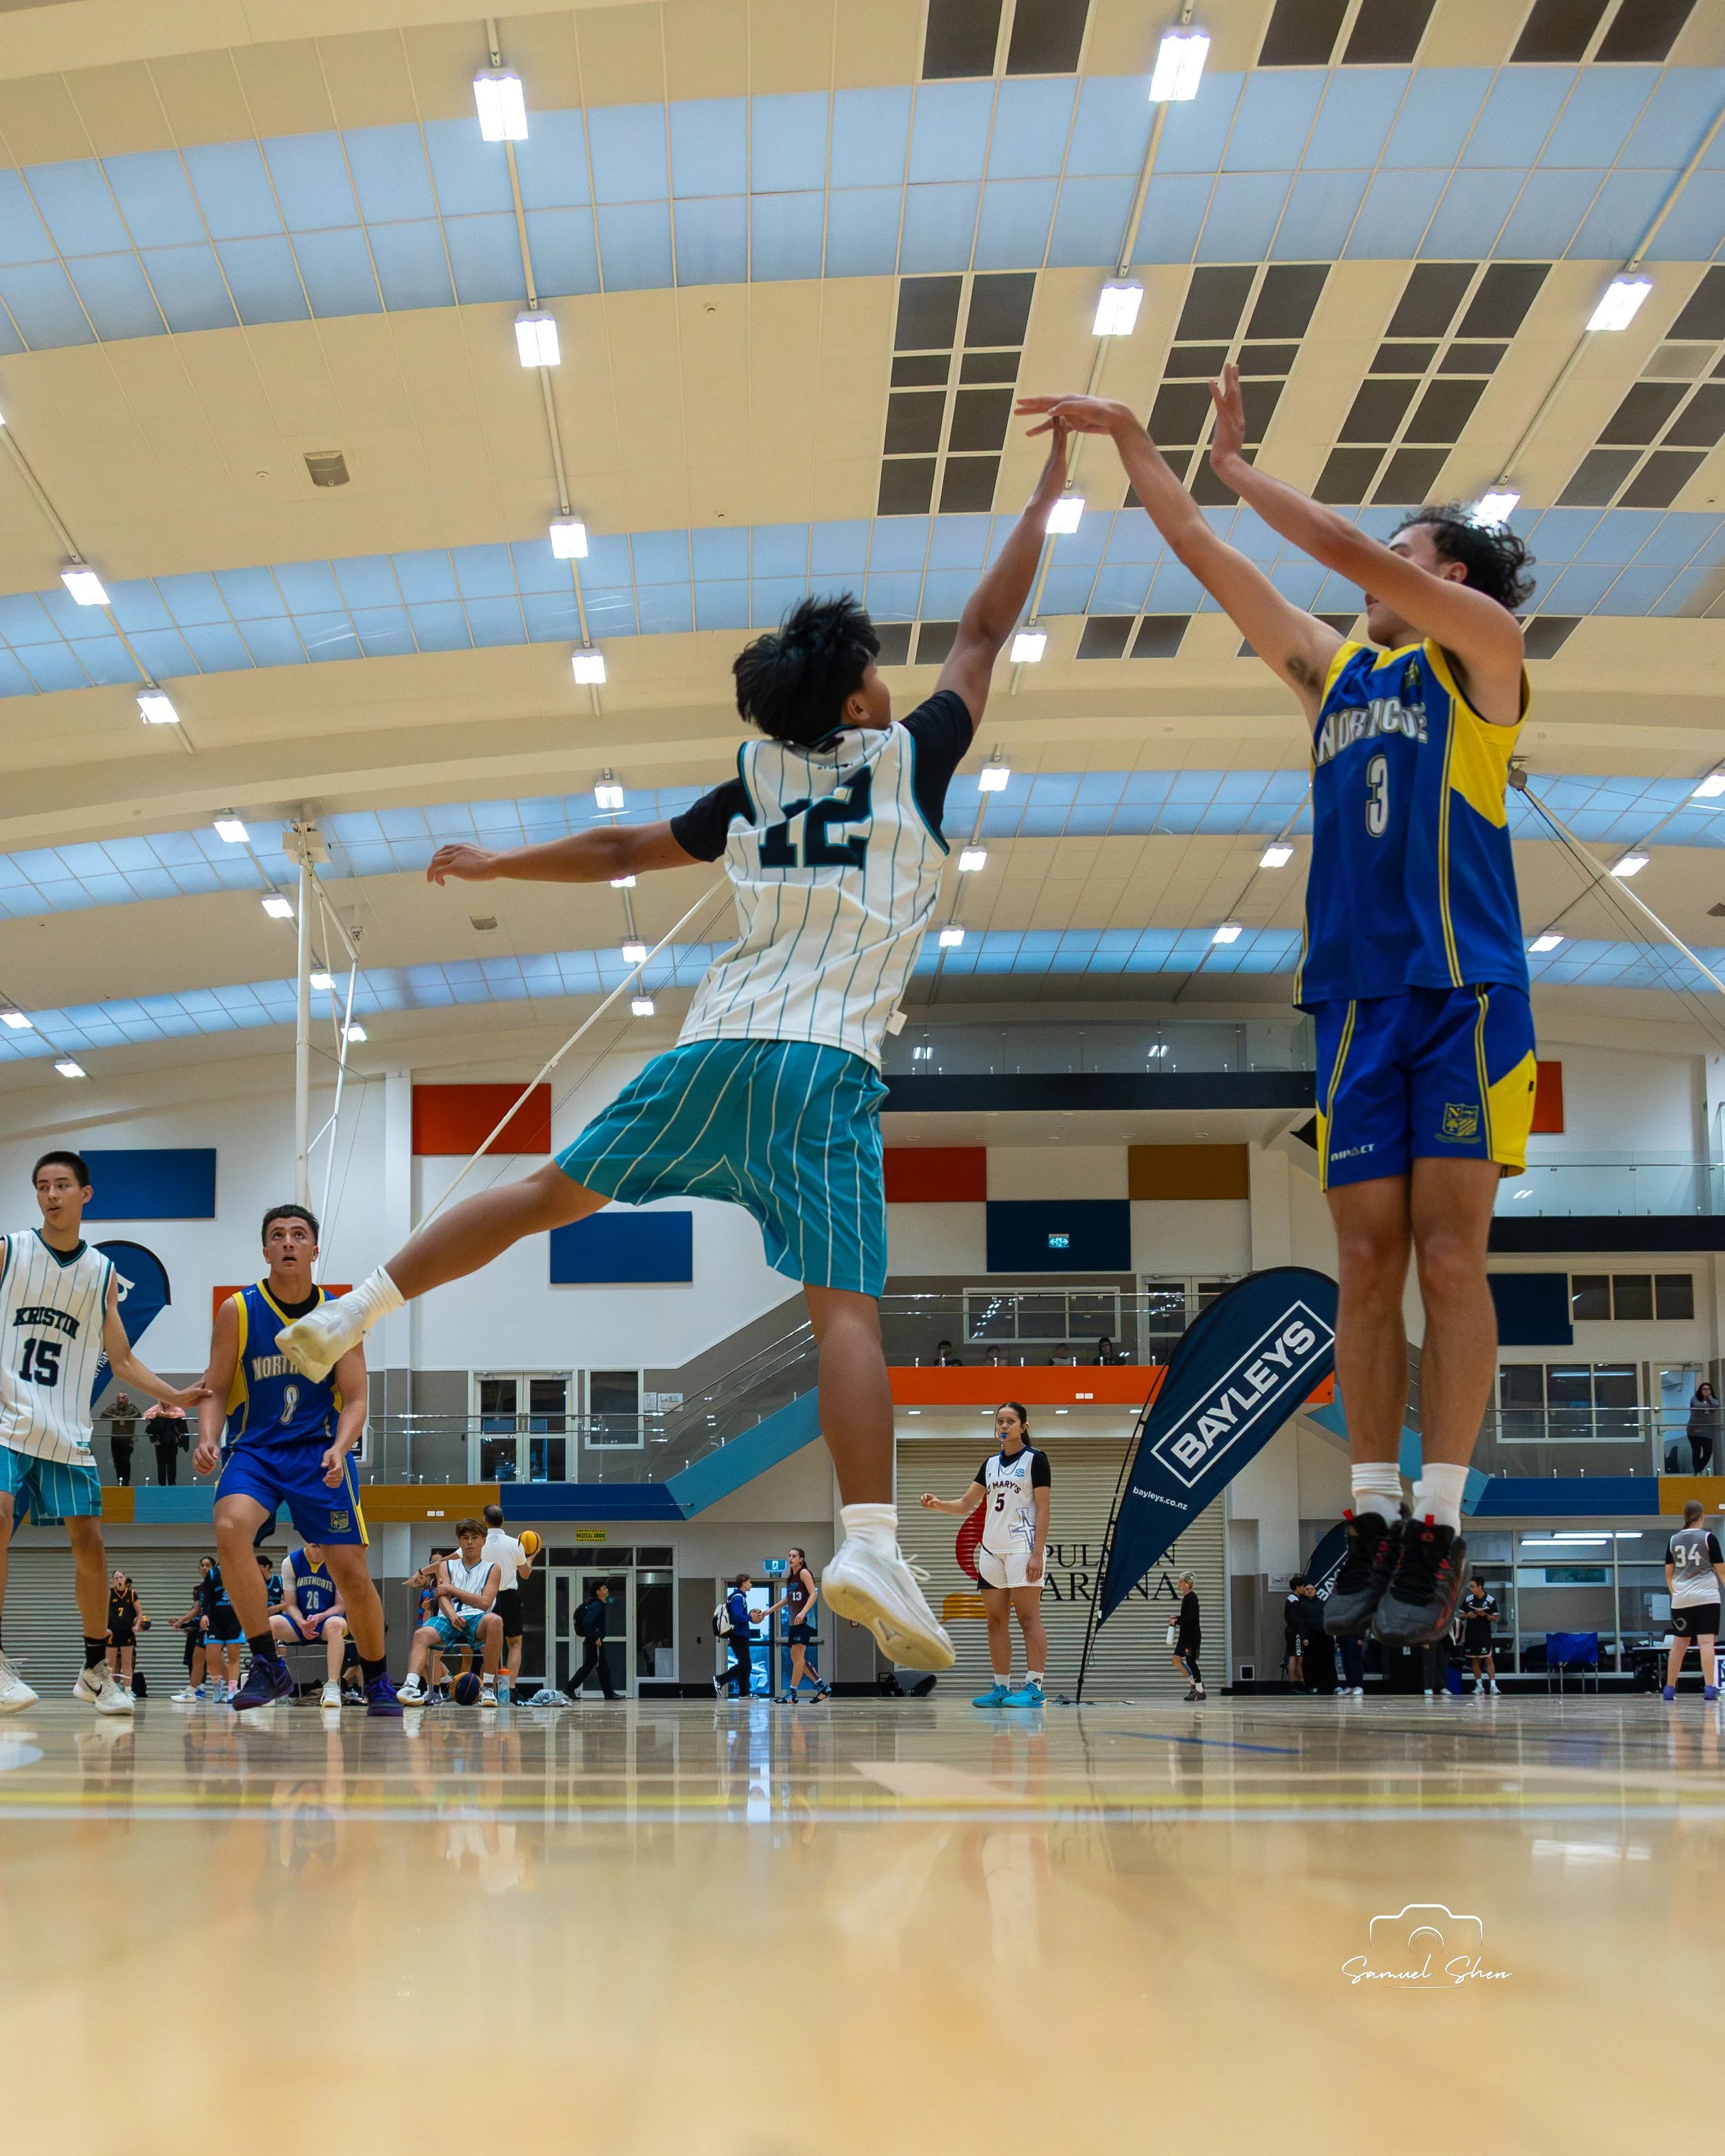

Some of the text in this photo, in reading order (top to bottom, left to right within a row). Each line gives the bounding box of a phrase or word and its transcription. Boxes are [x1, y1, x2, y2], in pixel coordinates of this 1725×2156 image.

[1366, 754, 1389, 838] 3
[758, 764, 873, 871] 12
[12, 1306, 81, 1341] KRISTIN
[19, 1337, 63, 1387] 15
[279, 1384, 299, 1425] 9
[1170, 1320, 1316, 1469] BAYLEYS
[992, 1480, 1022, 1494] MARY'S
[1132, 1485, 1188, 1511] bayleys.co.nz
[994, 1492, 1005, 1512] 5
[1045, 1543, 1180, 1567] PULN
[1674, 1543, 1702, 1568] 34
[792, 1591, 802, 1601] 13
[1040, 1571, 1182, 1601] ARNA
[118, 1607, 124, 1616] 7
[306, 1590, 319, 1610] 26
